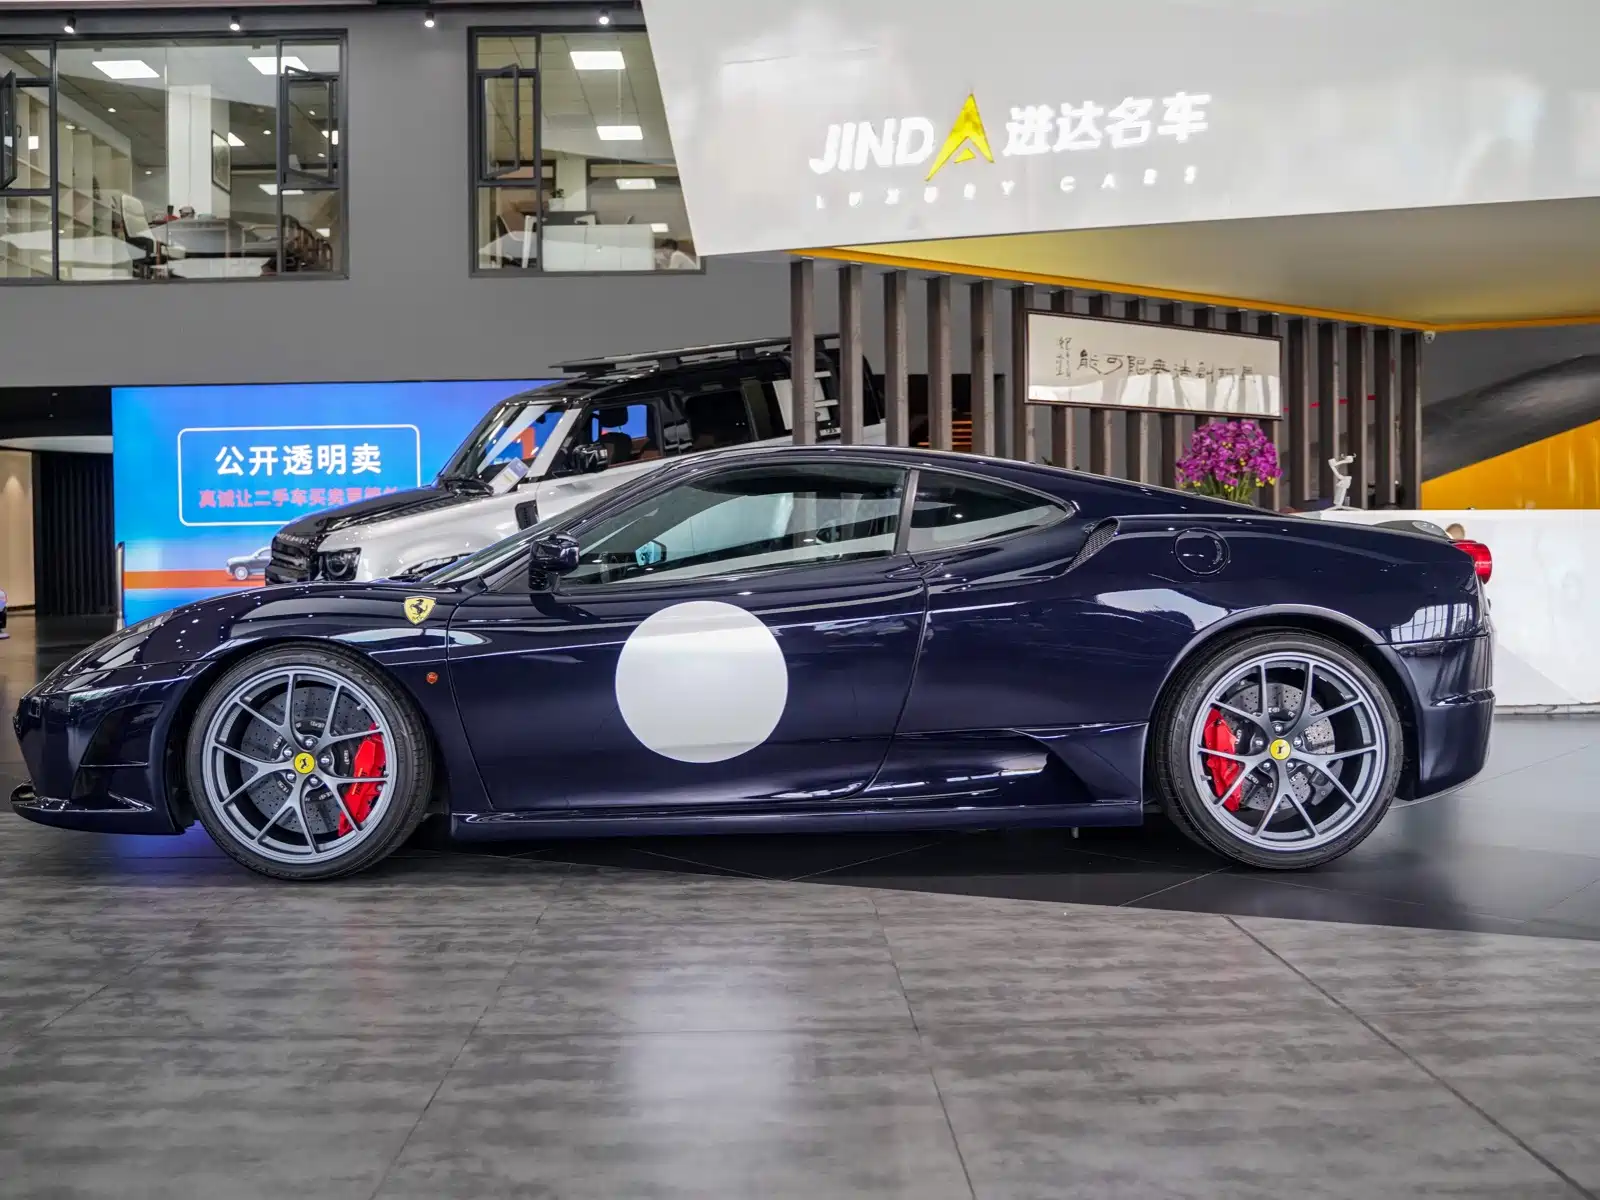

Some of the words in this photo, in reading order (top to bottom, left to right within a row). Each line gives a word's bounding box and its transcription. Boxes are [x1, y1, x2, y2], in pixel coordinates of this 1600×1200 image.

[1003, 91, 1211, 156] 进达名车
[215, 443, 382, 476] 公开透明卖
